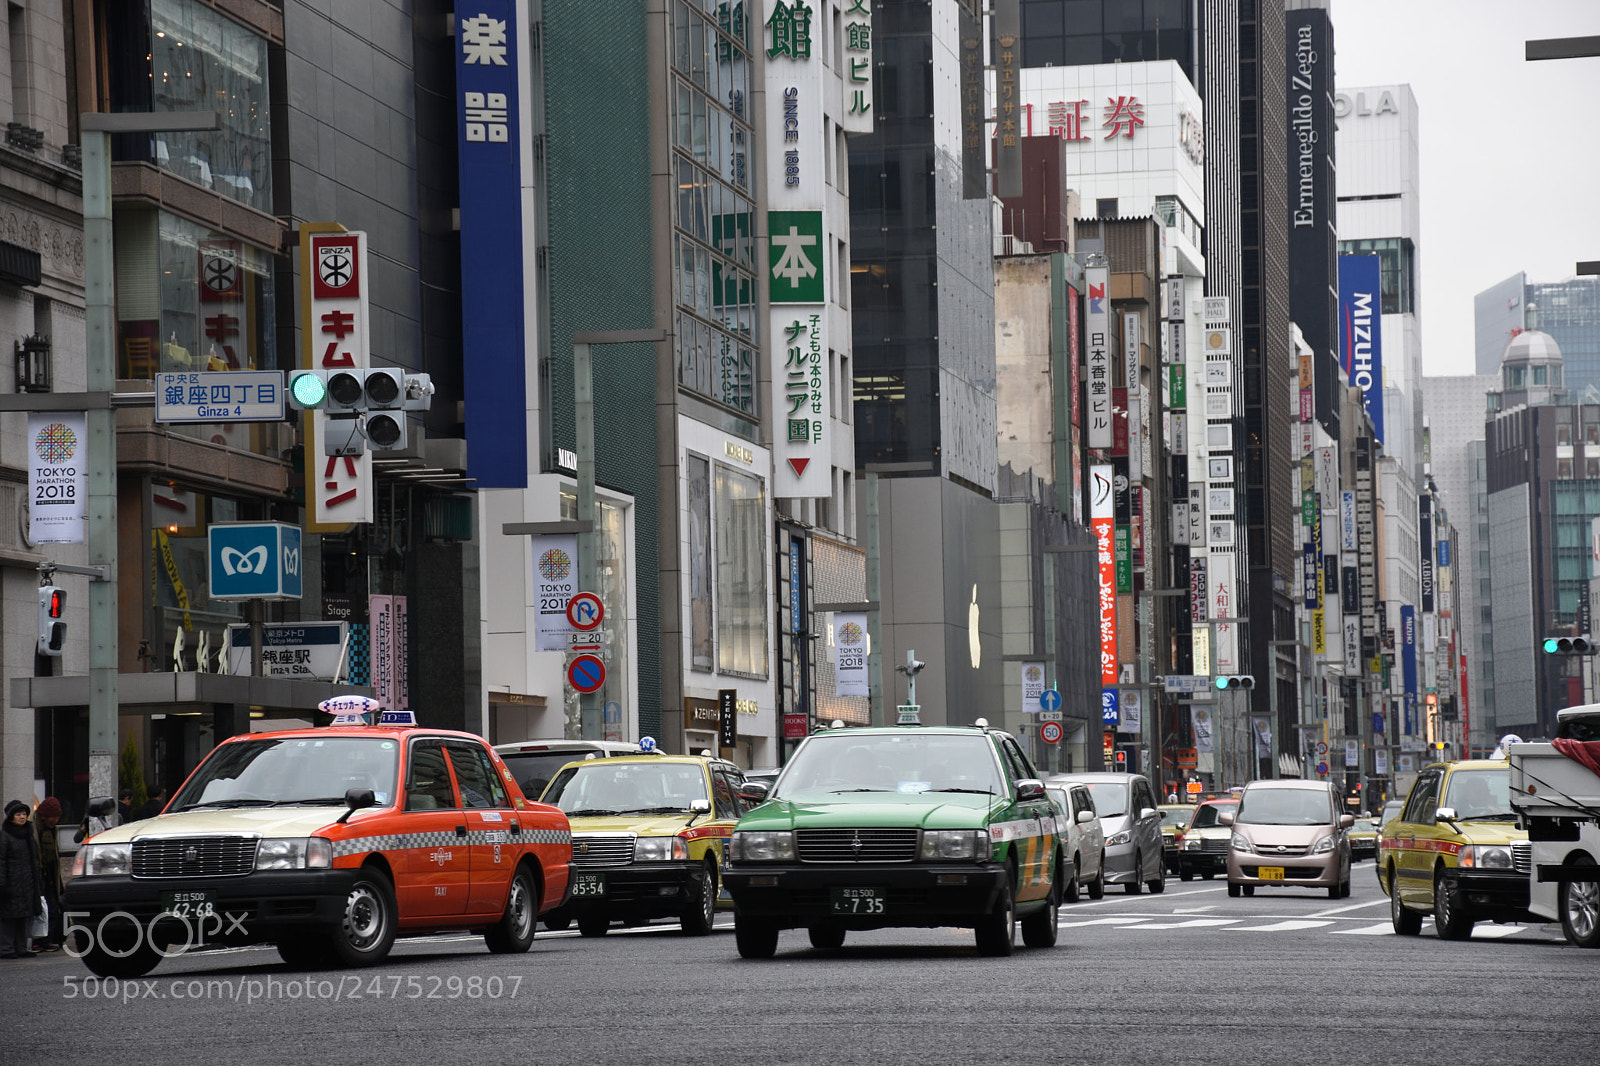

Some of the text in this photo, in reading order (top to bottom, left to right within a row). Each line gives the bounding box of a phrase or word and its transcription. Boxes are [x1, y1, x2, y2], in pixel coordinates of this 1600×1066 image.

[766, 1, 813, 60] 館
[461, 13, 509, 142] 楽器
[1292, 24, 1318, 229] Ermenegildo Zegna
[784, 86, 800, 186] SINCE 1885
[320, 247, 351, 255] GINZA
[771, 225, 818, 289] 本
[1353, 293, 1373, 388] MIZUHO
[808, 315, 823, 414] 子どもの本のみせ
[164, 373, 200, 384] 中央区
[785, 320, 810, 442] ナルニア国
[1090, 332, 1108, 430] 日本香堂ビル
[165, 384, 275, 406] 銀座四丁目
[197, 406, 243, 417] Ginza 4
[36, 467, 76, 477] TOKYO
[36, 485, 76, 498] 2018
[1305, 553, 1316, 600] 洋服の青山
[1422, 558, 1432, 596] ALBION
[540, 584, 572, 592] TOKYO
[328, 604, 350, 618] Stage
[1216, 582, 1230, 632] 大和証券
[1315, 613, 1323, 651] Network
[262, 649, 312, 664] 銀座駅
[840, 658, 863, 667] 2018
[332, 700, 360, 710] チェッカー
[698, 708, 718, 719] ZENITH
[1045, 728, 1058, 739] 50
[585, 875, 597, 885] 500
[190, 893, 205, 901] 500
[434, 886, 447, 896] TAXI
[572, 887, 603, 900] 85-54
[859, 889, 873, 897] 500
[173, 902, 213, 918] 62-68
